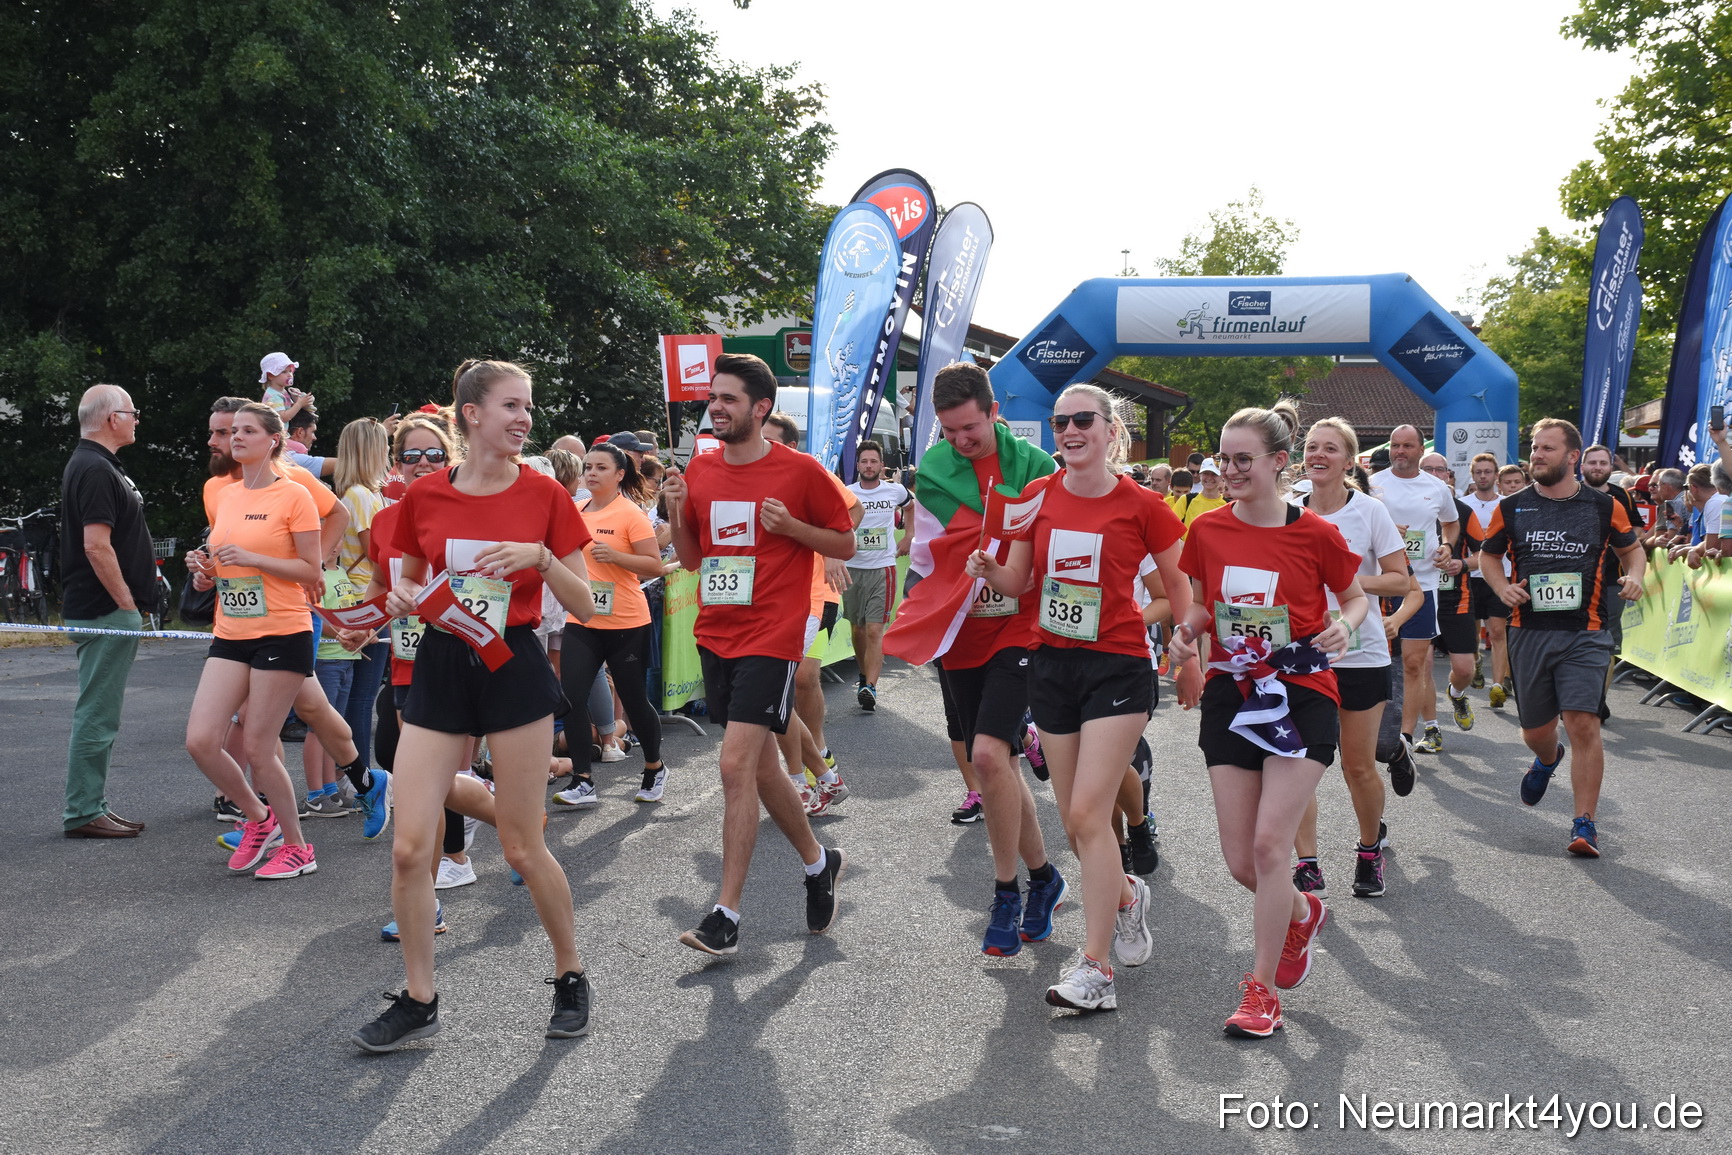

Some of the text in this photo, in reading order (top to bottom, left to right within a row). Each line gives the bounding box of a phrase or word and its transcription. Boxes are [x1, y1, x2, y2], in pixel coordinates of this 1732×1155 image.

[944, 225, 975, 312] Fischer
[957, 236, 980, 307] AUTOMOBILE
[1602, 221, 1629, 313] Fischer
[1237, 300, 1269, 308] Fischer
[1213, 316, 1307, 333] firmenlauf
[1036, 348, 1086, 359] Fischer
[863, 536, 881, 545] 941
[1525, 531, 1567, 542] HECK
[1530, 542, 1590, 553] DESIGN
[1064, 559, 1082, 568] DEHN
[708, 573, 739, 592] 533
[221, 591, 259, 607] 2303
[974, 585, 1004, 604] 08
[1239, 595, 1256, 603] DEHN
[1536, 586, 1576, 601] 1014
[1048, 598, 1083, 624] 538
[1231, 622, 1273, 643] 556
